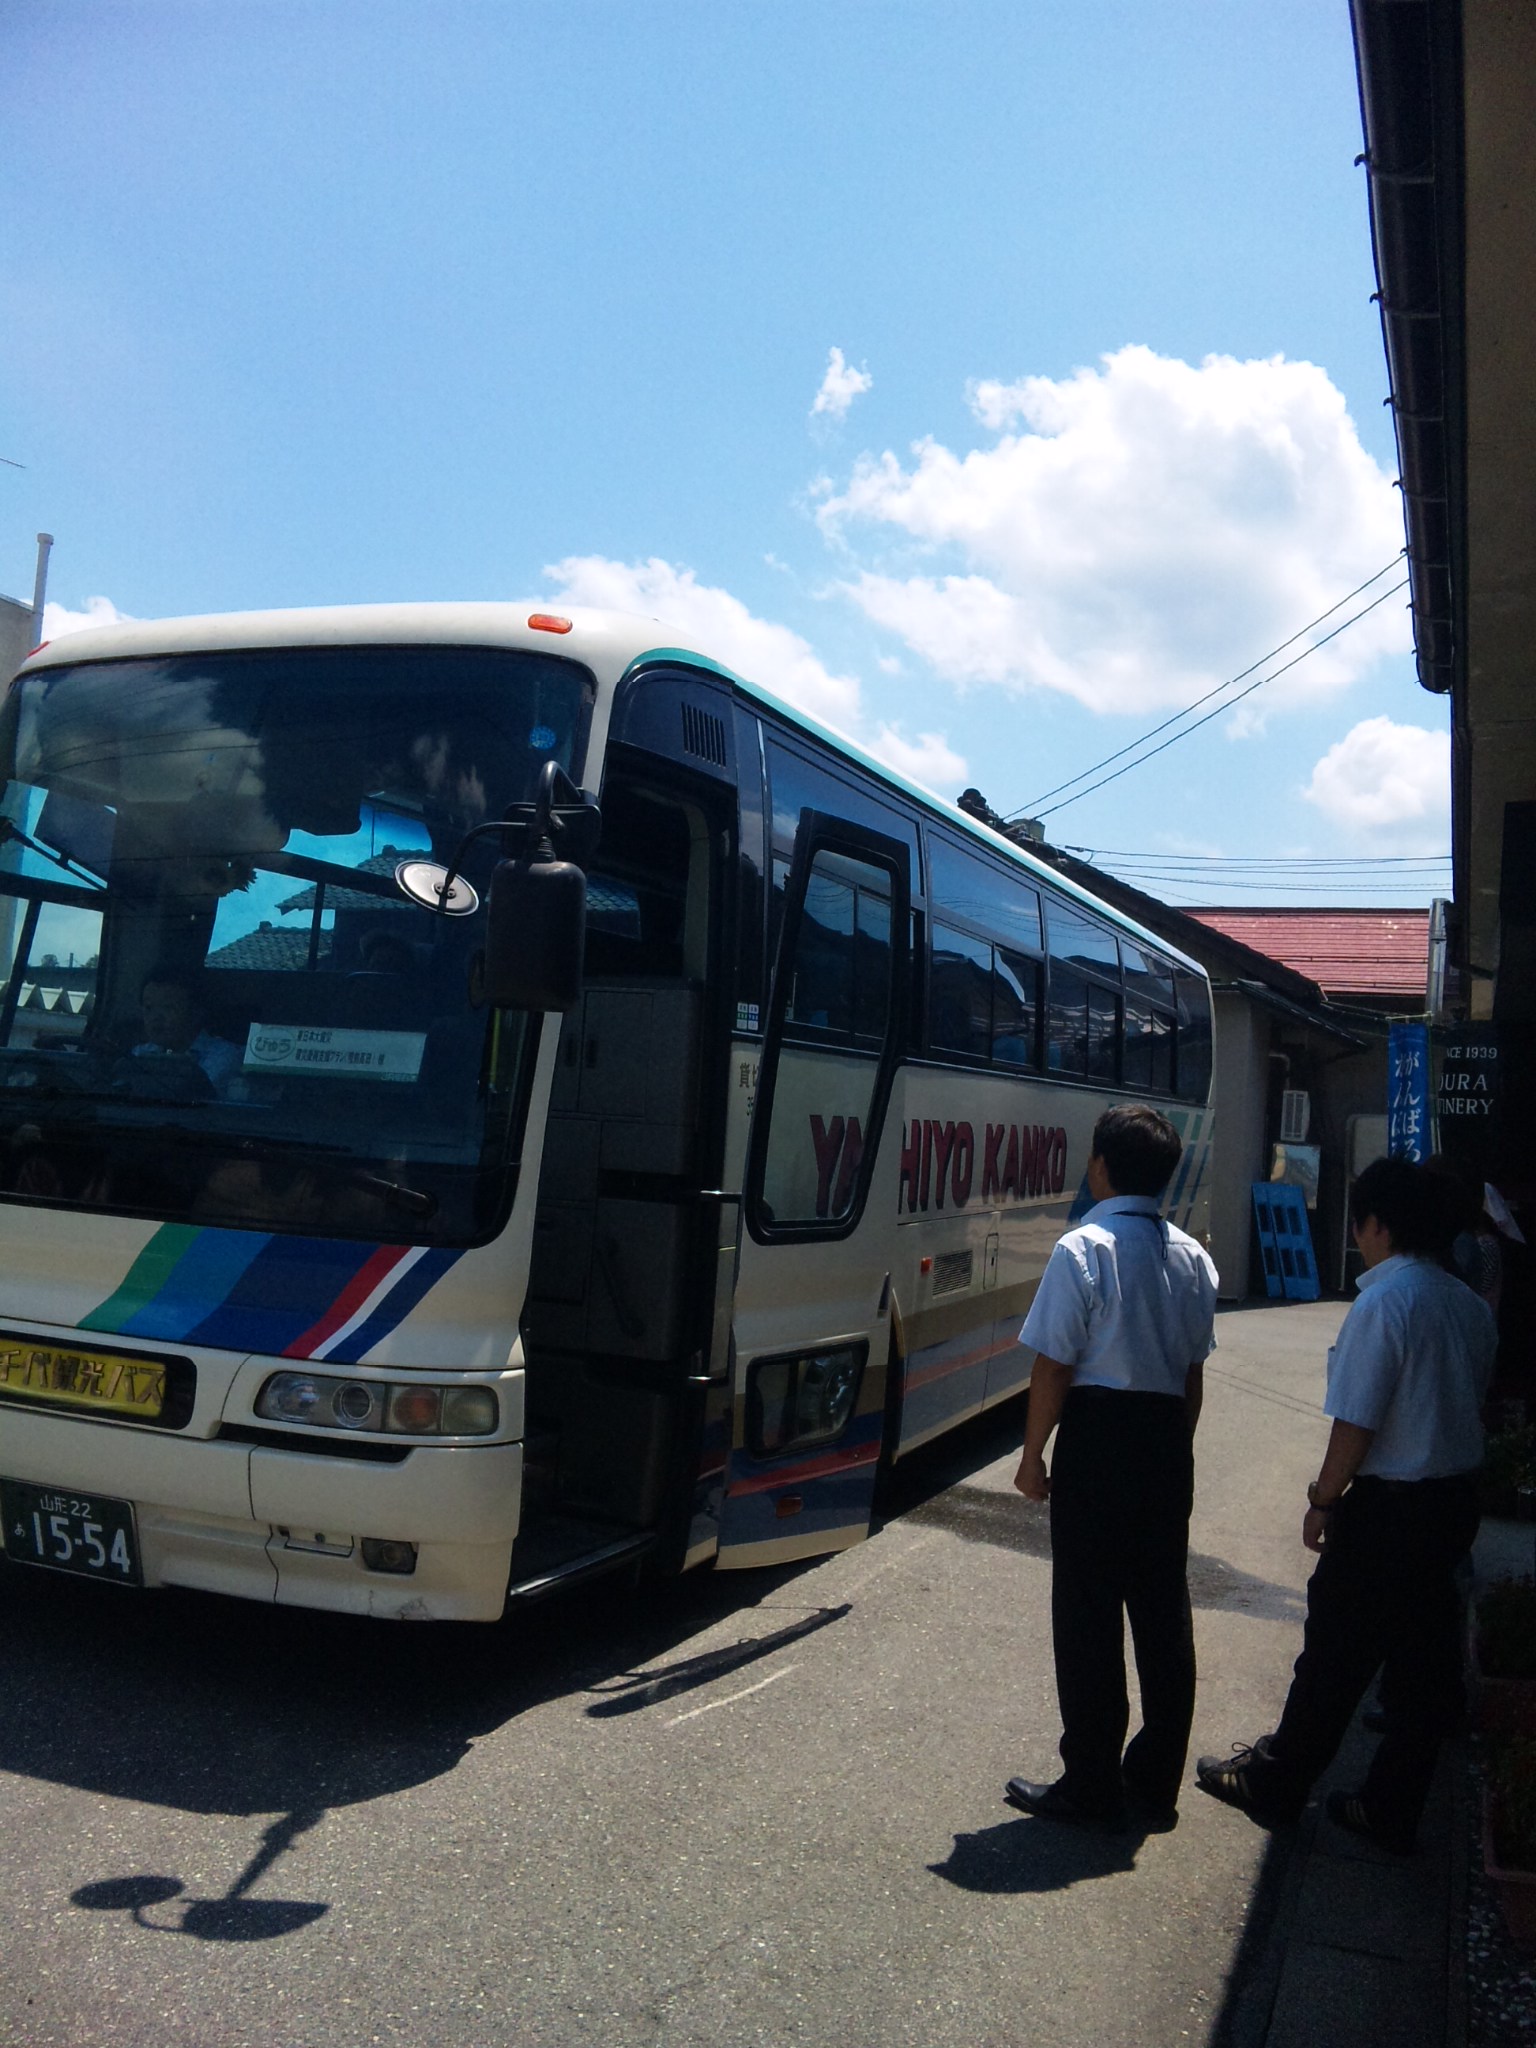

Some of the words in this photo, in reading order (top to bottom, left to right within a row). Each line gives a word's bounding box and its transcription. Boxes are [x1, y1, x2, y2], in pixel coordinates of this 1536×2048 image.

[1466, 1046, 1498, 1059] 1939
[981, 1123, 1067, 1204] KANKO
[32, 1511, 131, 1574] 15-54
